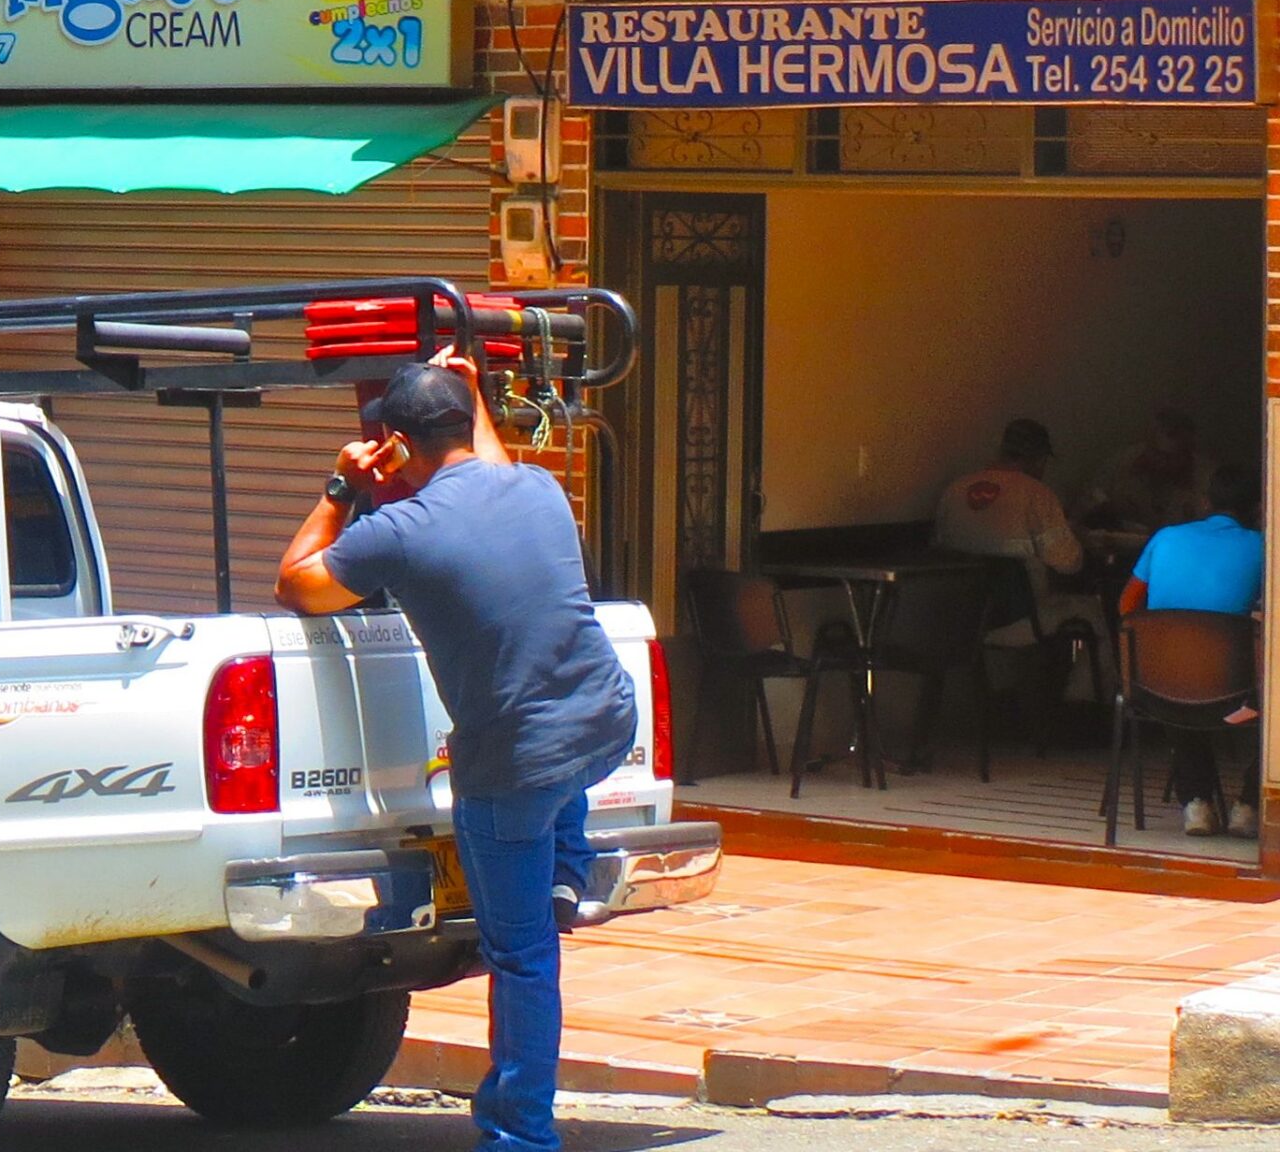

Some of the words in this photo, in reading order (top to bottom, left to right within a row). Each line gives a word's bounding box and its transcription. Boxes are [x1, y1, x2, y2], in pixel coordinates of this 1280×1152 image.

[125, 10, 241, 48] CREAM
[330, 16, 423, 68] 2x1
[580, 6, 927, 44] RESTAURANTE
[1027, 6, 1116, 46] Servicio
[1121, 15, 1134, 46] a
[1140, 6, 1245, 46] Domicilio
[578, 46, 723, 96] VILLA
[737, 43, 1019, 94] HERMOSA
[1025, 54, 1080, 93] Tel.
[1090, 54, 1148, 93] 254
[1157, 54, 1196, 93] 32
[1204, 54, 1244, 94] 25
[291, 767, 362, 790] B2600
